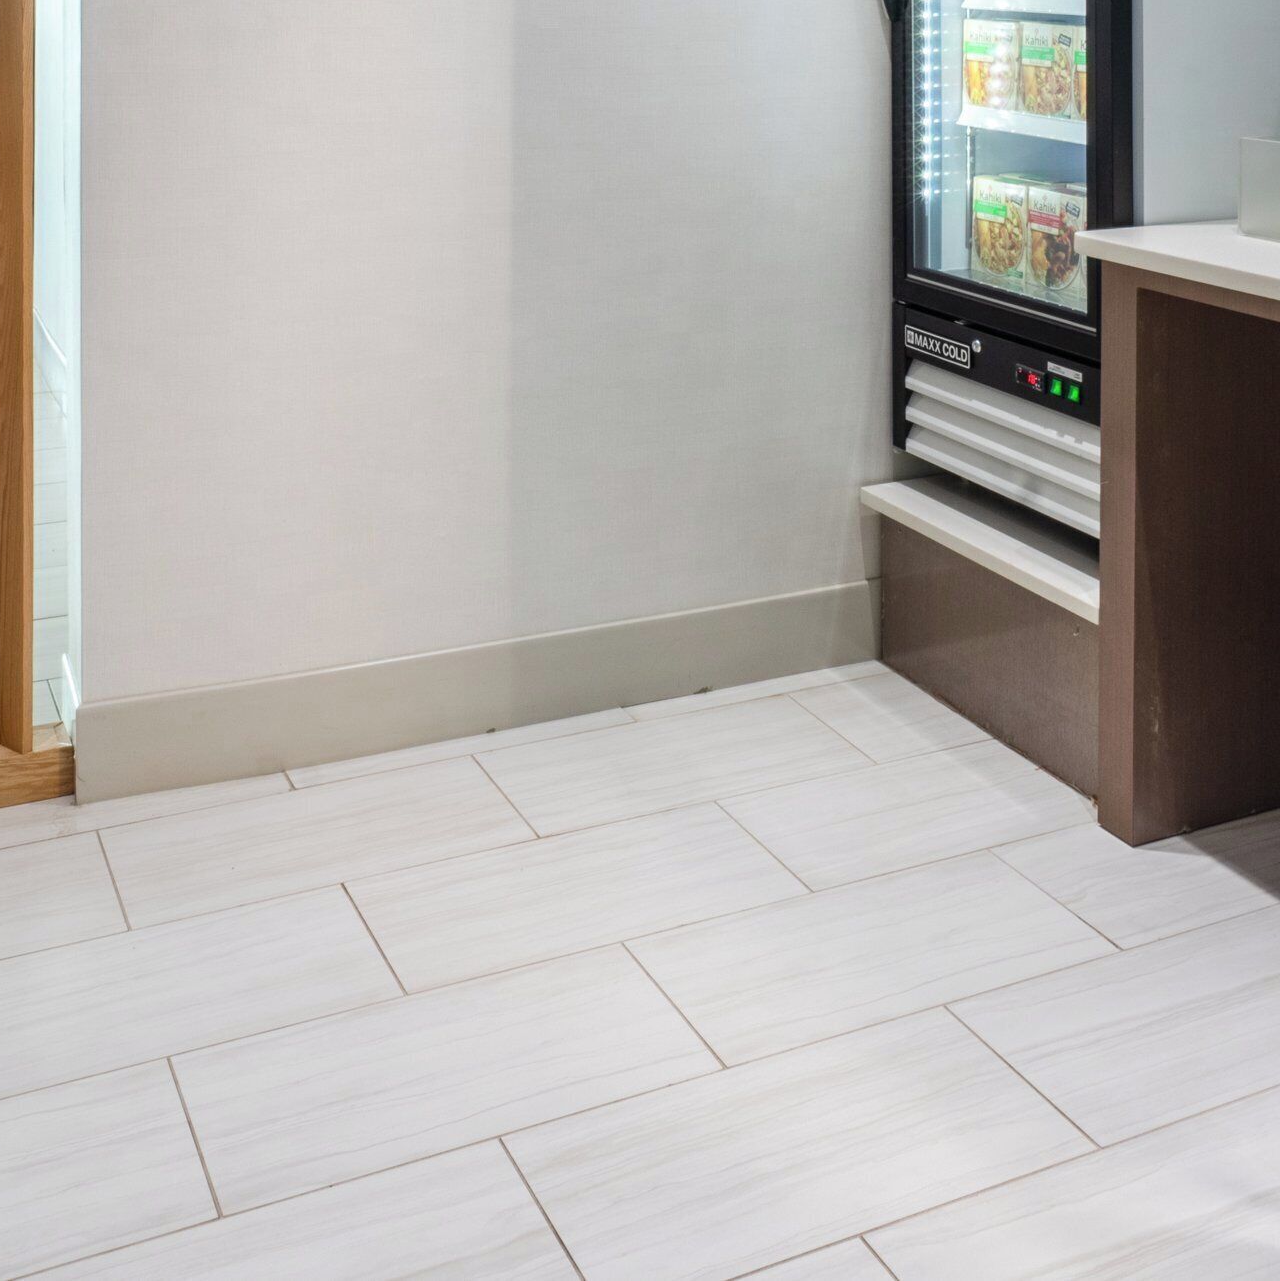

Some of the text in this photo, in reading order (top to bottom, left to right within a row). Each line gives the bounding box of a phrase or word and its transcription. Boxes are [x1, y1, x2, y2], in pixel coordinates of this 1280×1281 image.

[1033, 200, 1057, 214] Kahiki
[914, 333, 968, 362] MAXX COLD
